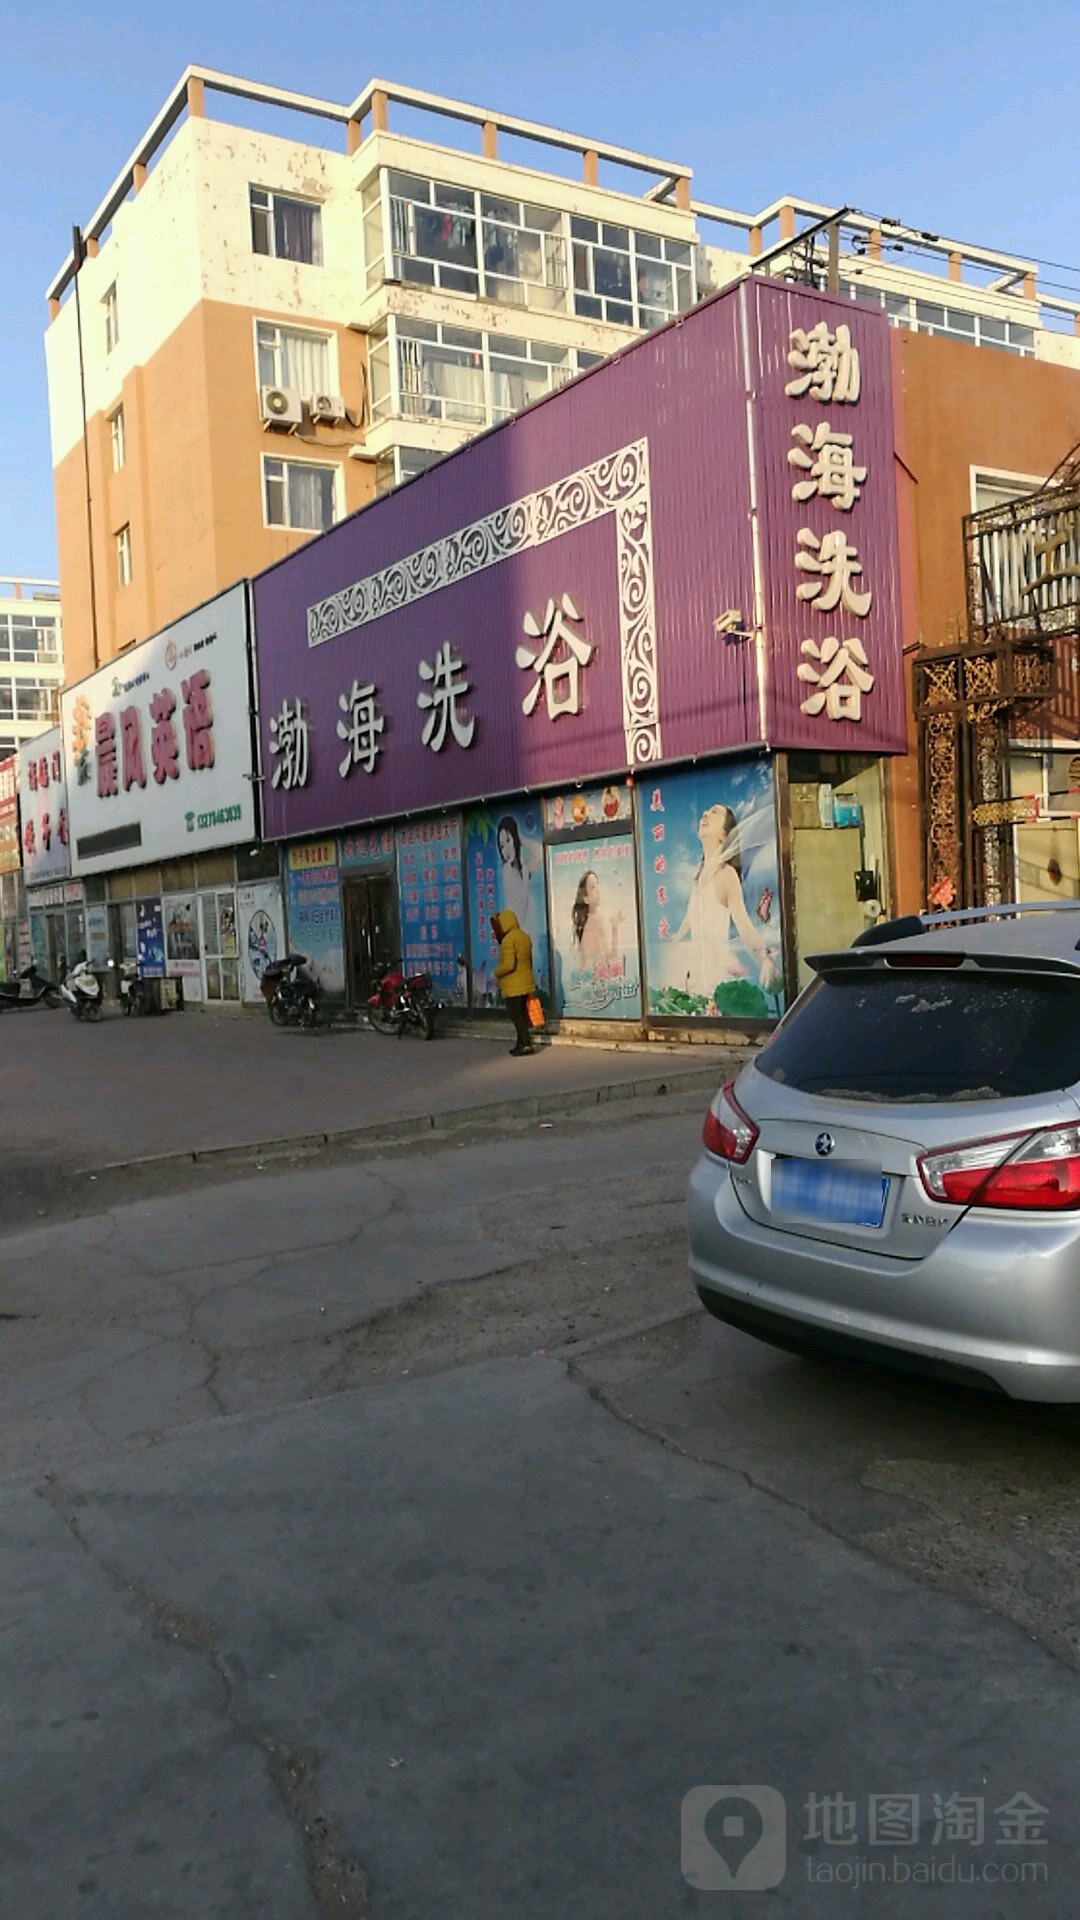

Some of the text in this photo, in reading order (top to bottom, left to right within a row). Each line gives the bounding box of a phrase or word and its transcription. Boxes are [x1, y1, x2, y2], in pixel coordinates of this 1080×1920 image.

[785, 321, 874, 721] 渤海洗浴
[269, 593, 593, 790] 渤海洗浴
